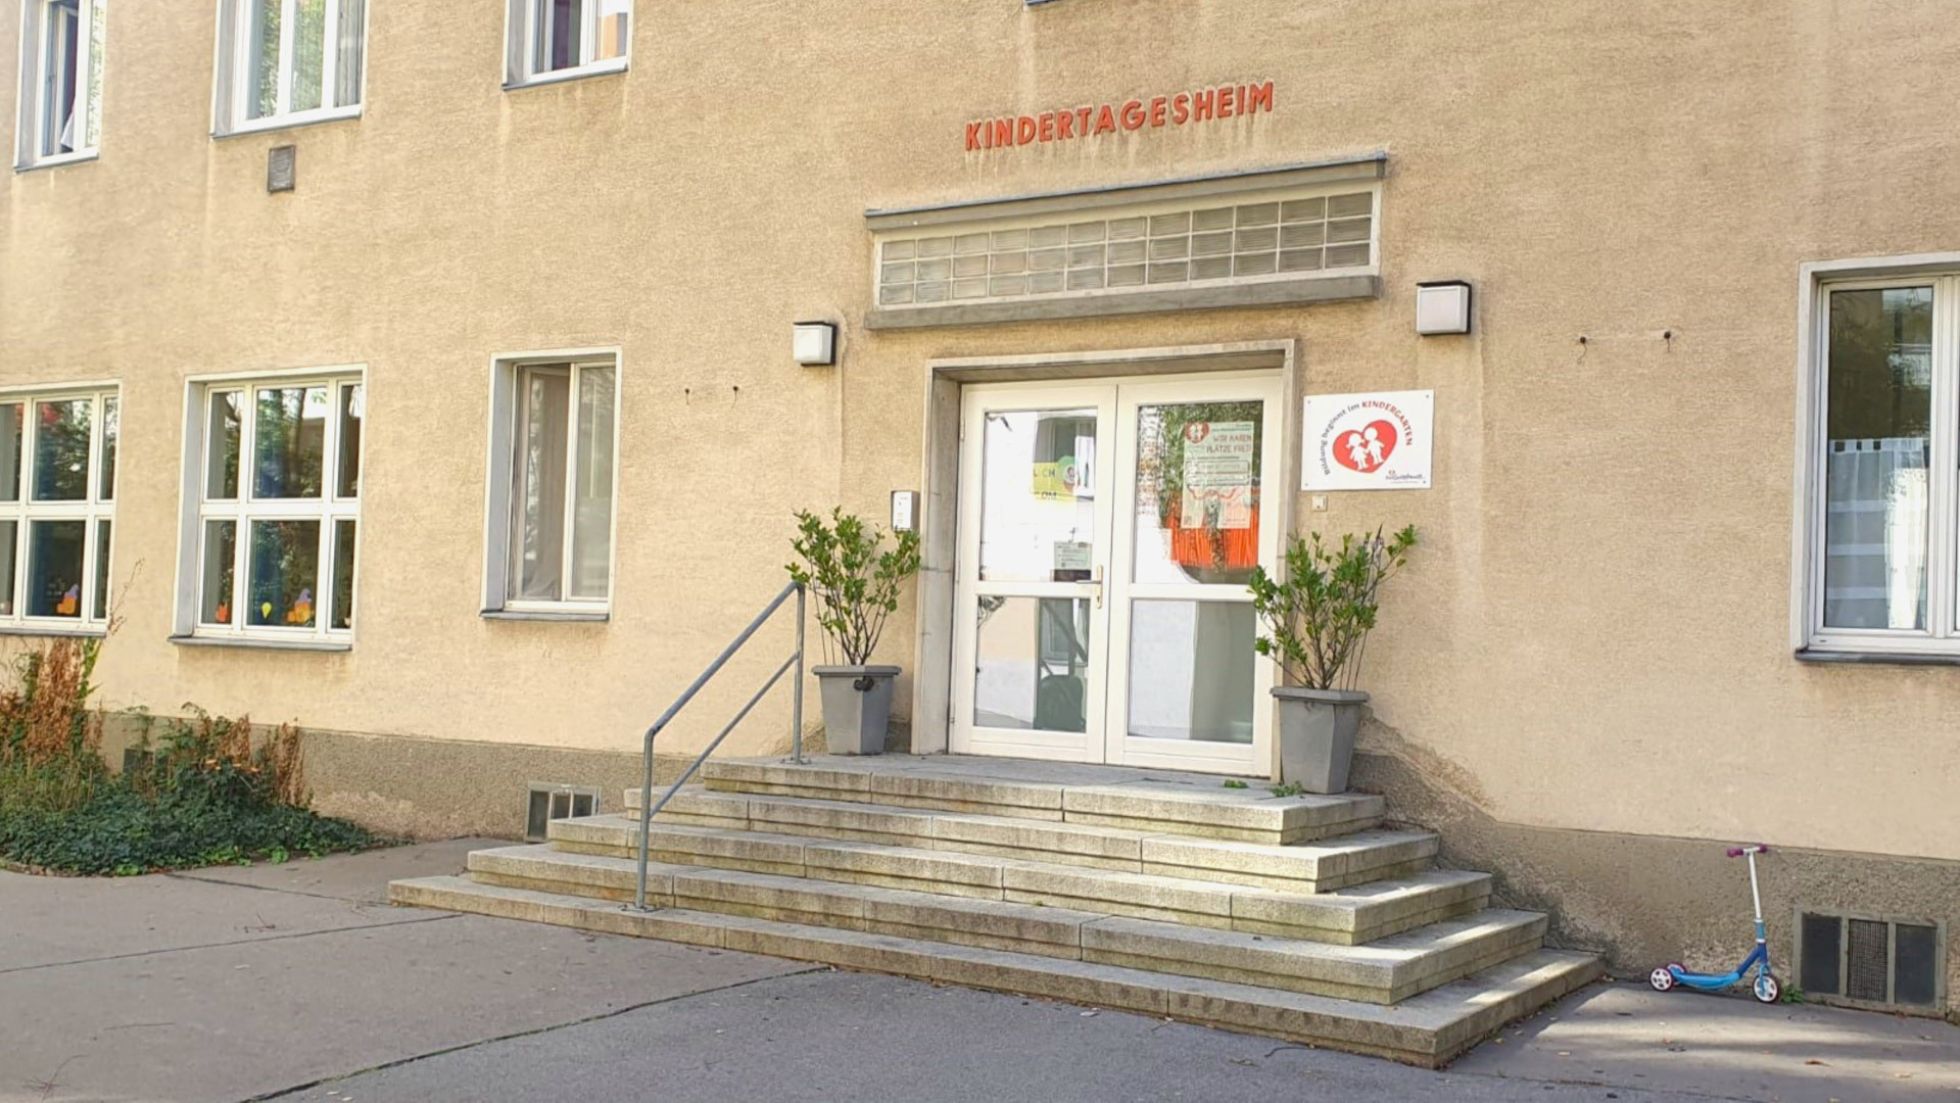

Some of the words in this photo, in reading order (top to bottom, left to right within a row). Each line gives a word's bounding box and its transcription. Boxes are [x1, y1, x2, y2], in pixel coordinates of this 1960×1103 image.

[965, 82, 1274, 150] KINDERTAGESHEIM
[1322, 409, 1346, 438] beginnt
[1347, 404, 1360, 412] im
[1362, 400, 1412, 446] KINDERGARTEN
